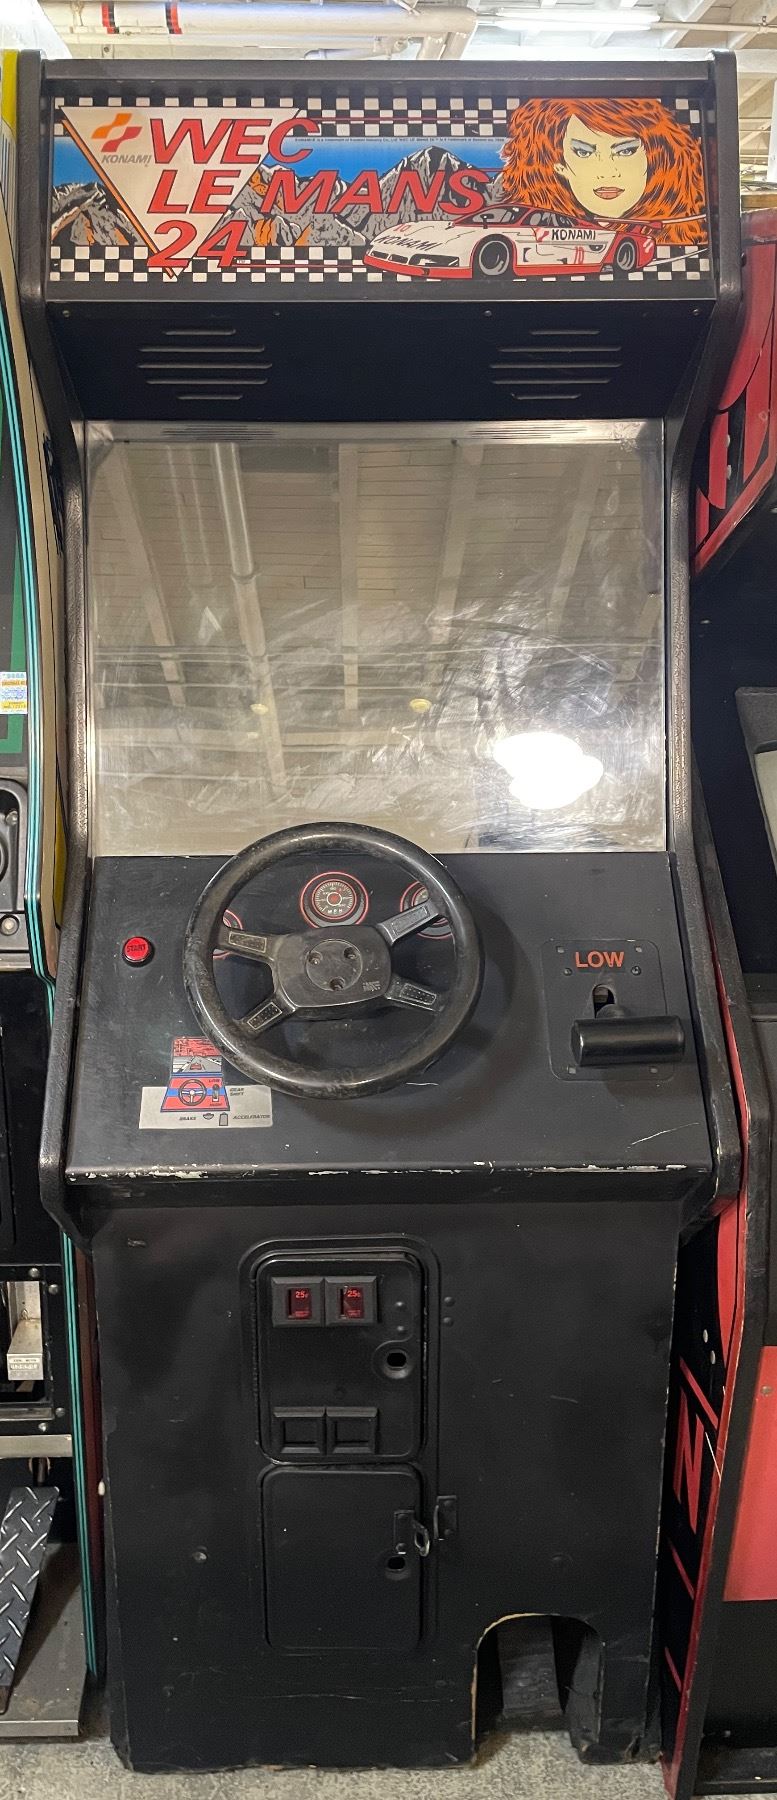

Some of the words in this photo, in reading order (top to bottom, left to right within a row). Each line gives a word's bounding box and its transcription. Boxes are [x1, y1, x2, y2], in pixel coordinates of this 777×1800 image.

[149, 118, 321, 165] WEC
[101, 154, 152, 167] KONAMI
[147, 169, 241, 214] LE
[259, 169, 491, 215] MANS
[375, 235, 443, 251] KONAMI
[551, 228, 596, 240] KONAMI
[146, 219, 249, 268] 24
[575, 950, 625, 968] LOW
